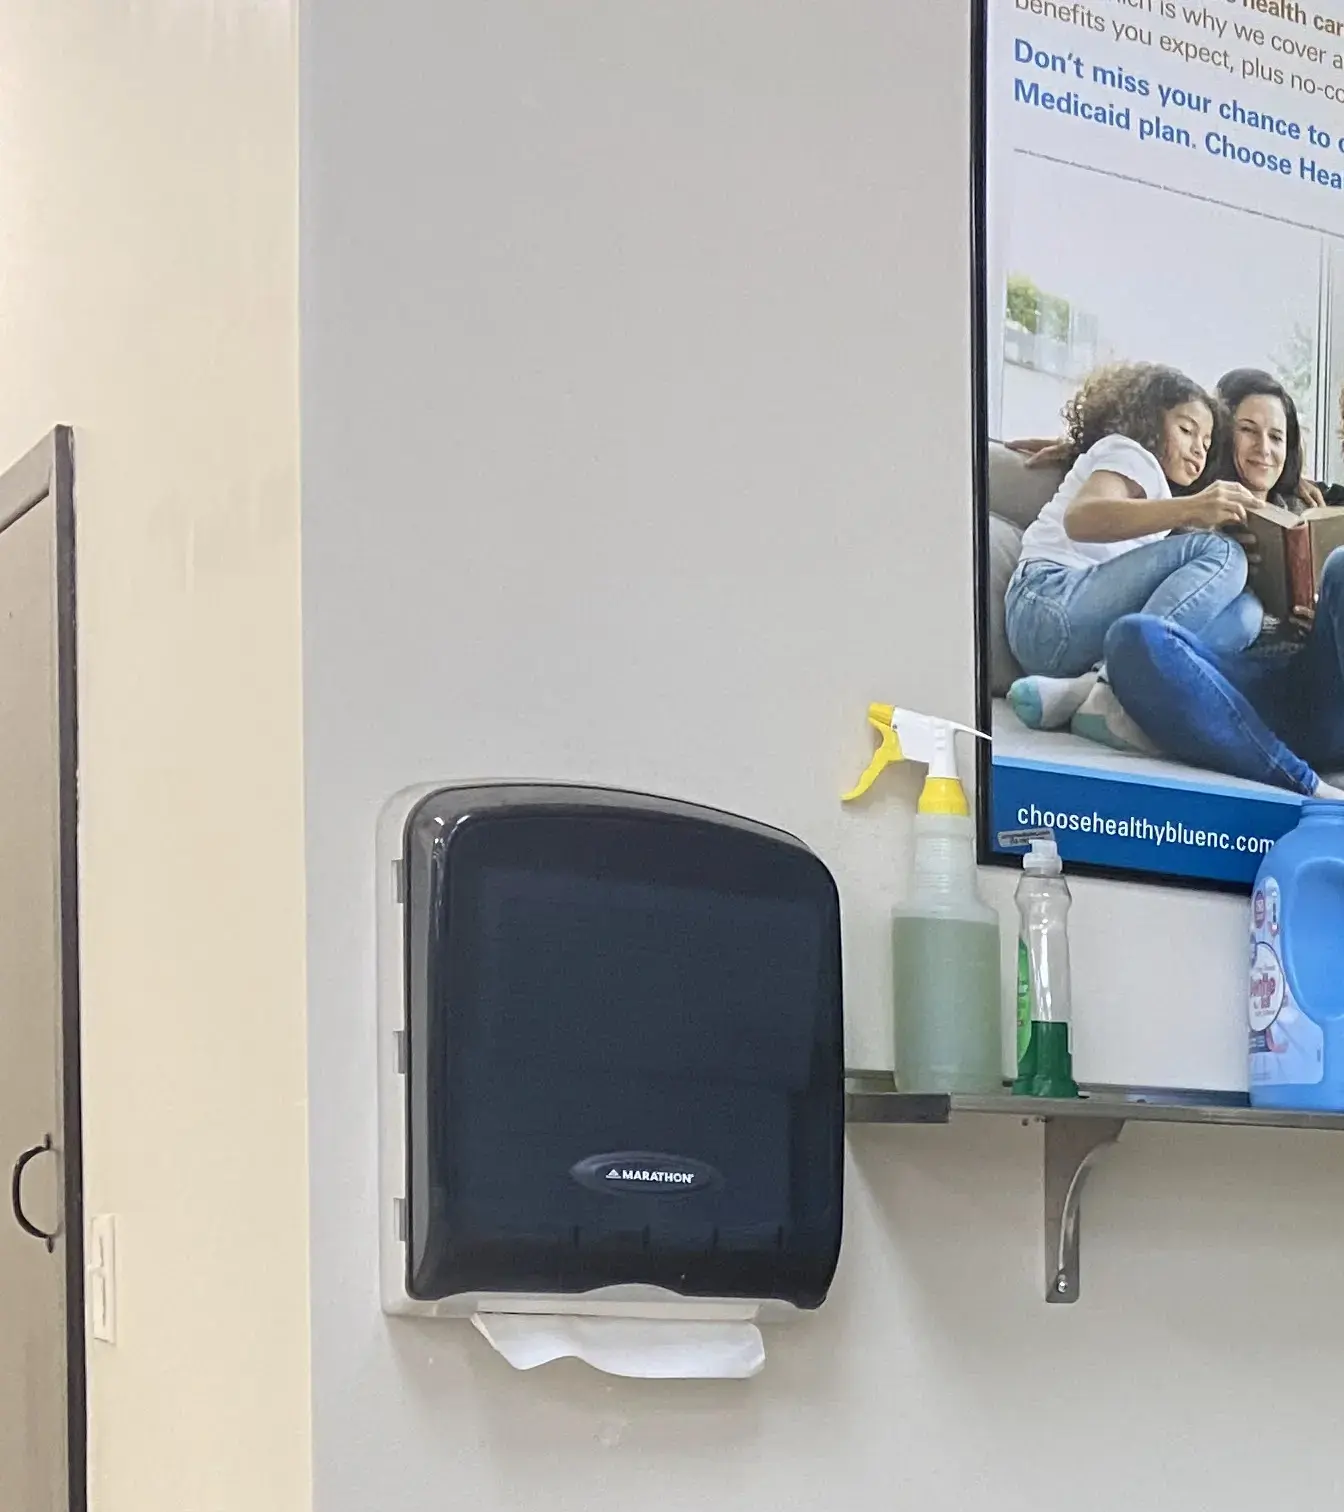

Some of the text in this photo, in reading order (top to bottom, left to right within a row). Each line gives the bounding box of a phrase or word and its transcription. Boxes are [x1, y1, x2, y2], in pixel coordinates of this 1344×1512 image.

[1112, 19, 1151, 46] you
[1159, 34, 1235, 74] expect,
[1242, 57, 1285, 86] plus
[1181, 7, 1227, 38] why
[1234, 22, 1265, 46] we
[1270, 34, 1327, 65] cover
[1014, 37, 1084, 79] Don't
[1092, 65, 1151, 97] miss
[1157, 83, 1212, 114] your
[1219, 101, 1301, 140] chance
[1307, 125, 1331, 149] to
[1014, 77, 1131, 131] Medicaid
[1139, 115, 1197, 150] plan.
[1204, 131, 1292, 176] Choose
[1016, 803, 1275, 854] choosehealthybluenc.com
